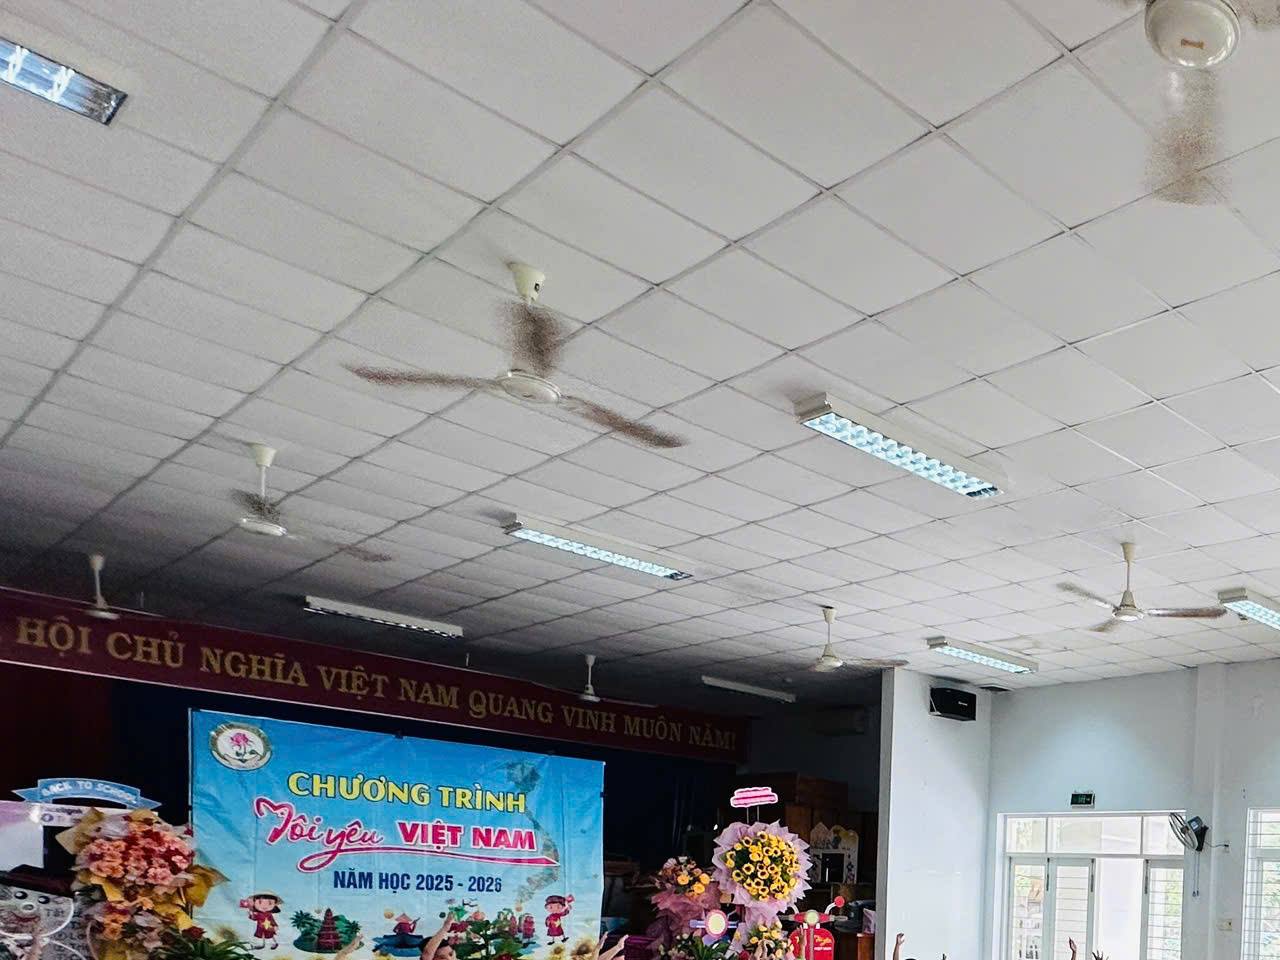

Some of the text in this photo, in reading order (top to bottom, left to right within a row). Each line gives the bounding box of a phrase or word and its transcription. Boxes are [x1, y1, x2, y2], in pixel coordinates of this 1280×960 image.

[16, 615, 93, 657] HỘI
[106, 631, 186, 667] CHỦ
[200, 648, 309, 687] NGHĨA
[316, 664, 389, 700] VIỆT
[399, 679, 459, 710] NAM
[469, 690, 554, 724] QUANG
[562, 706, 616, 734] VINH
[624, 715, 682, 742] MUÔN
[78, 781, 93, 789] TO
[288, 772, 527, 814] CHƯƠNG TRÌNH
[297, 820, 384, 873] yêu
[397, 820, 463, 853] VIỆT
[471, 827, 537, 850] NAM
[333, 867, 374, 890] NĂM
[378, 874, 411, 894] HỌC
[416, 874, 454, 892] 2025
[467, 876, 503, 893] 2026
